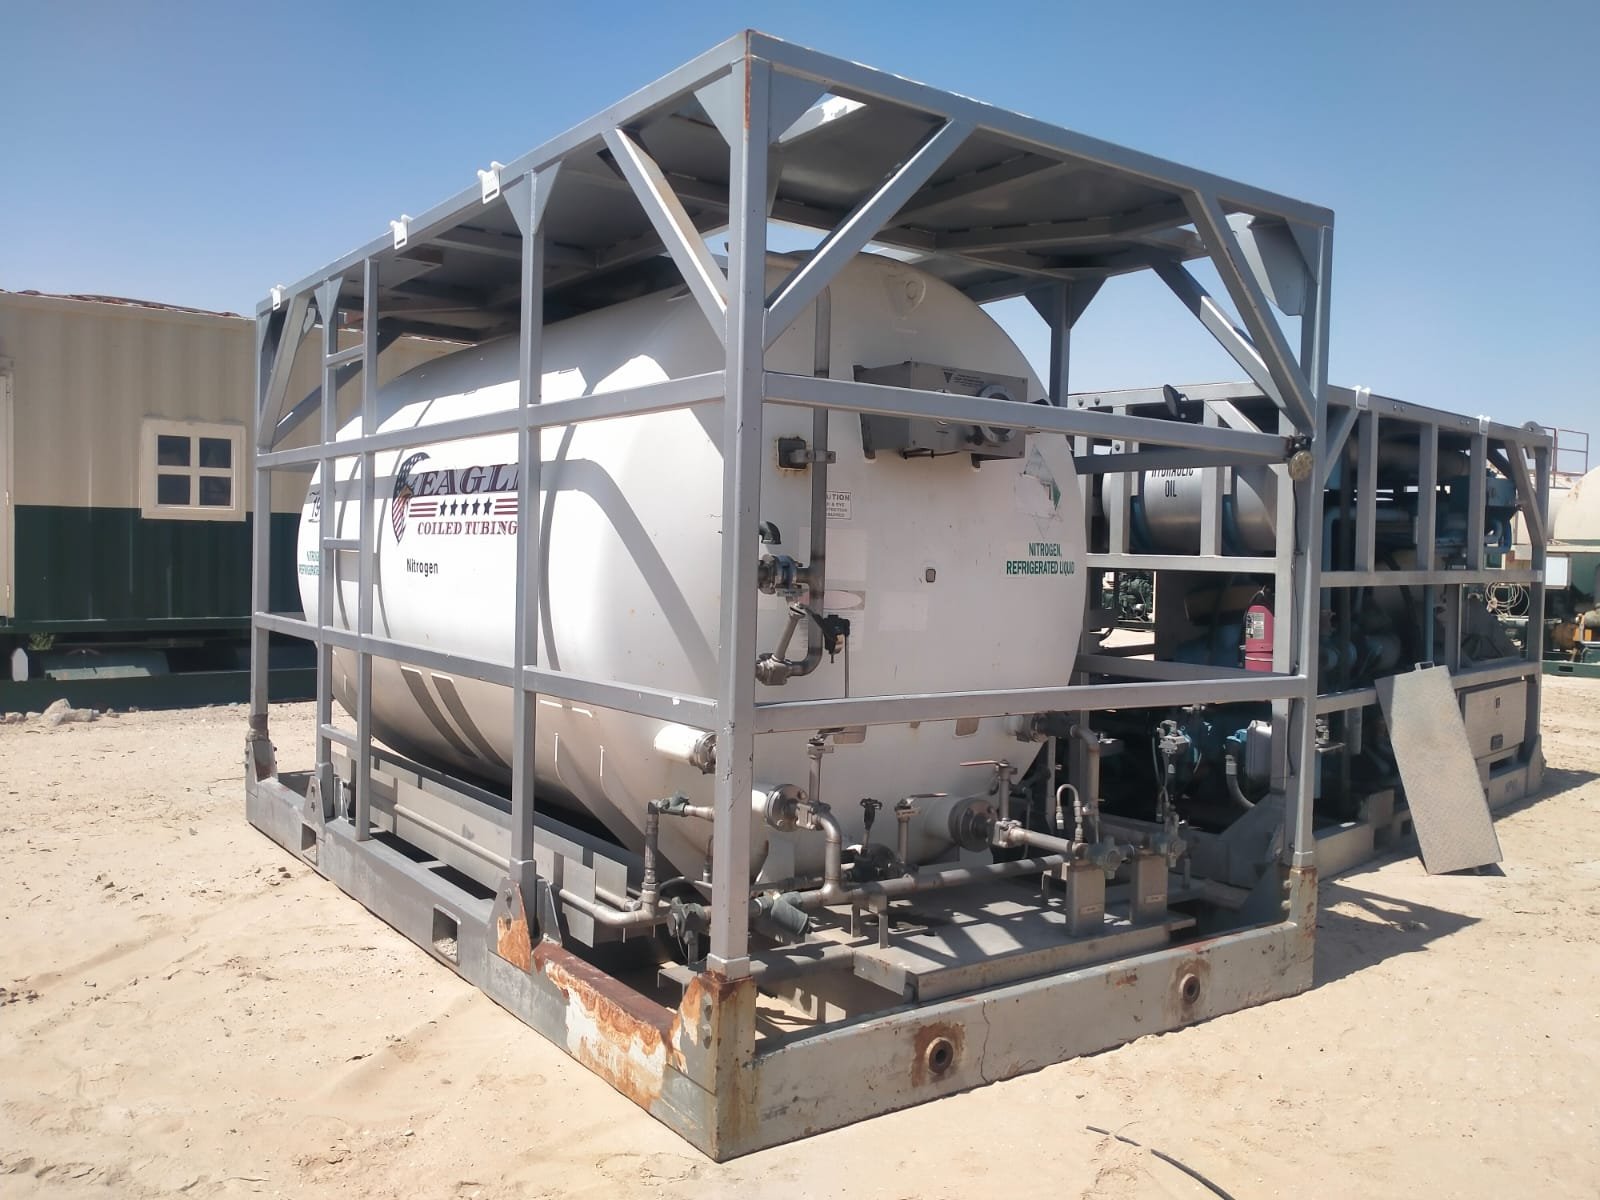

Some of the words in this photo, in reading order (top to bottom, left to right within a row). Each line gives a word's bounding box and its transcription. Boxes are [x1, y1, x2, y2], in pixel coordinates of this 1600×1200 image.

[417, 463, 519, 497] EAGL
[1165, 480, 1177, 497] OIL
[418, 521, 462, 535] COILED
[465, 520, 518, 535] TUBING
[406, 557, 439, 577] Nitrogen
[1006, 560, 1059, 575] REFRIGERATED
